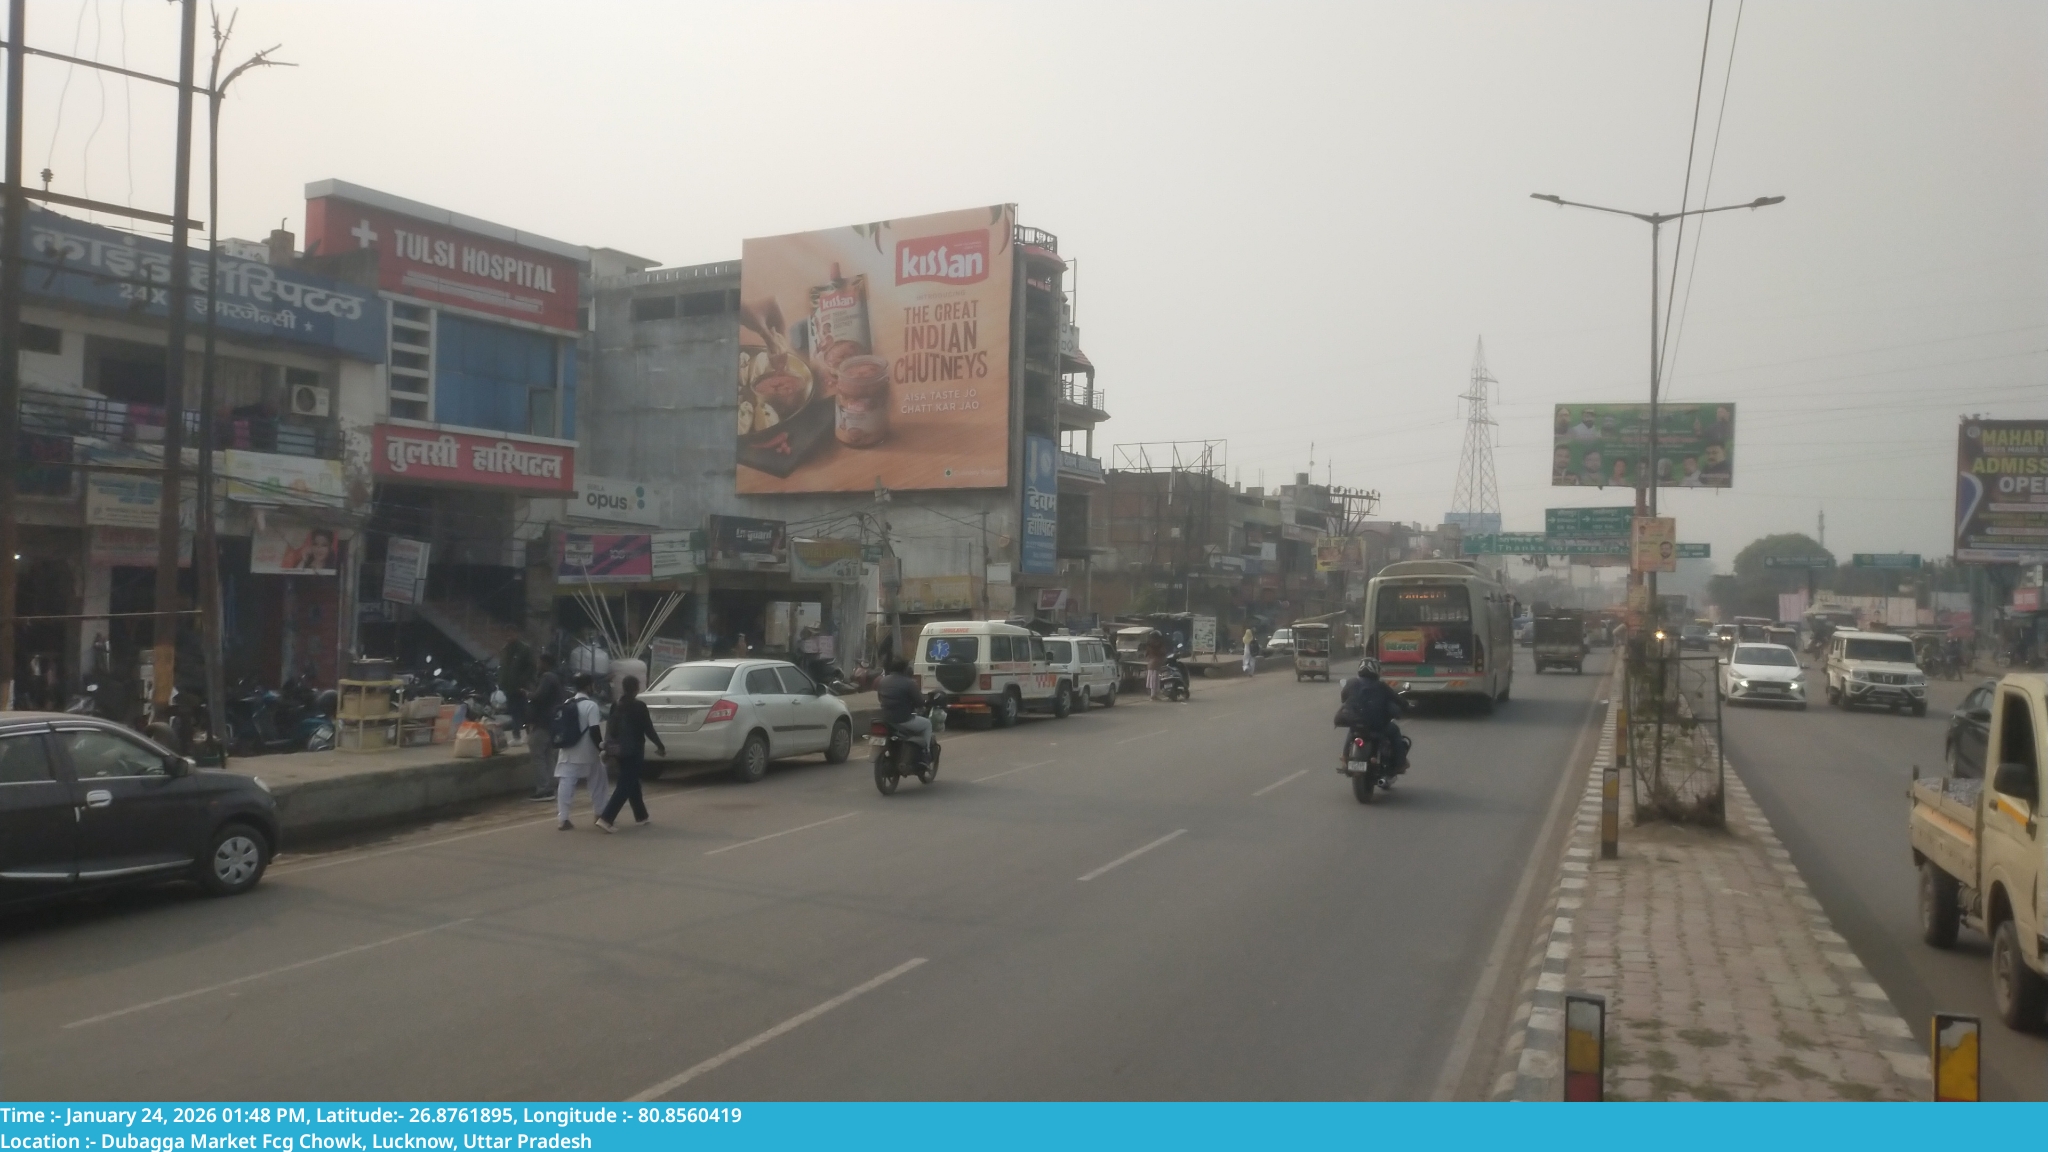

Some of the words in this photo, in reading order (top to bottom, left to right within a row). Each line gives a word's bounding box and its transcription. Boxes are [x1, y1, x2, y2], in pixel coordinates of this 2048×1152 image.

[394, 229, 455, 269] TULSI
[462, 245, 556, 294] HOSPITAL
[902, 245, 983, 279] kissan
[916, 290, 967, 301] INTRODUCING
[903, 305, 930, 325] THE
[934, 300, 979, 322] GREAT
[904, 320, 978, 353] INDIAN
[893, 350, 988, 385] CHUTNEYS
[904, 392, 927, 402] AISA
[930, 389, 960, 401] TASTE
[964, 388, 977, 398] JO
[901, 404, 933, 415] CHATT
[936, 402, 956, 412] KAR
[959, 400, 980, 411] JAO
[1982, 429, 2048, 447] MAHAR
[386, 434, 461, 473] तुलसी
[1999, 476, 2048, 494] OPE
[586, 492, 628, 511] opus
